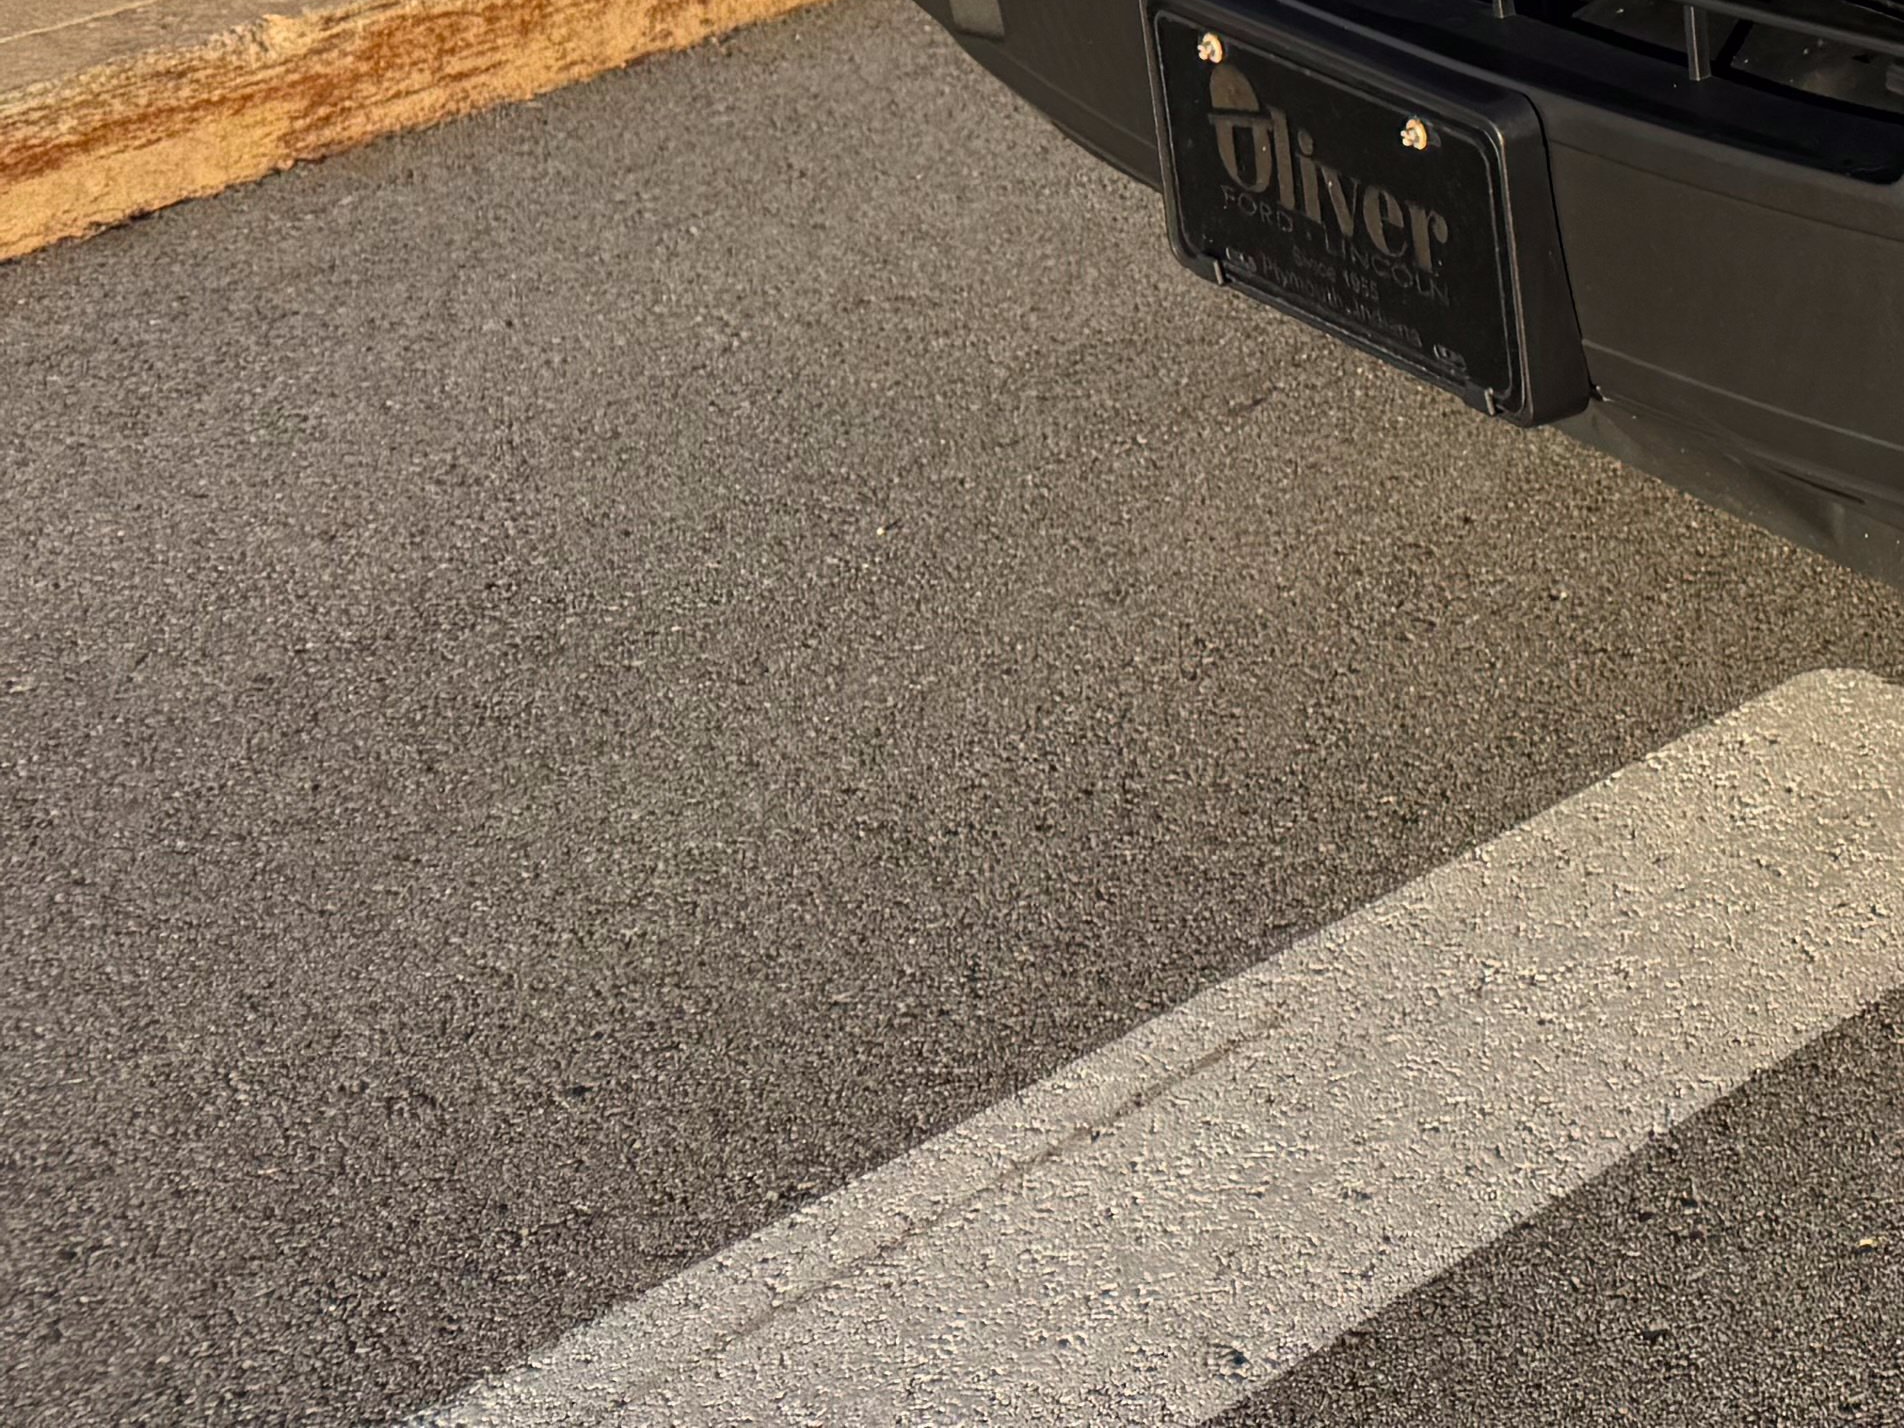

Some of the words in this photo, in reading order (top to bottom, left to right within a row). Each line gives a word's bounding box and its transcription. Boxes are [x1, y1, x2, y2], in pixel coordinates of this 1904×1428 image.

[1207, 65, 1449, 274] Oliver
[1220, 185, 1294, 233] FORD
[1323, 221, 1450, 307] LINCOLN
